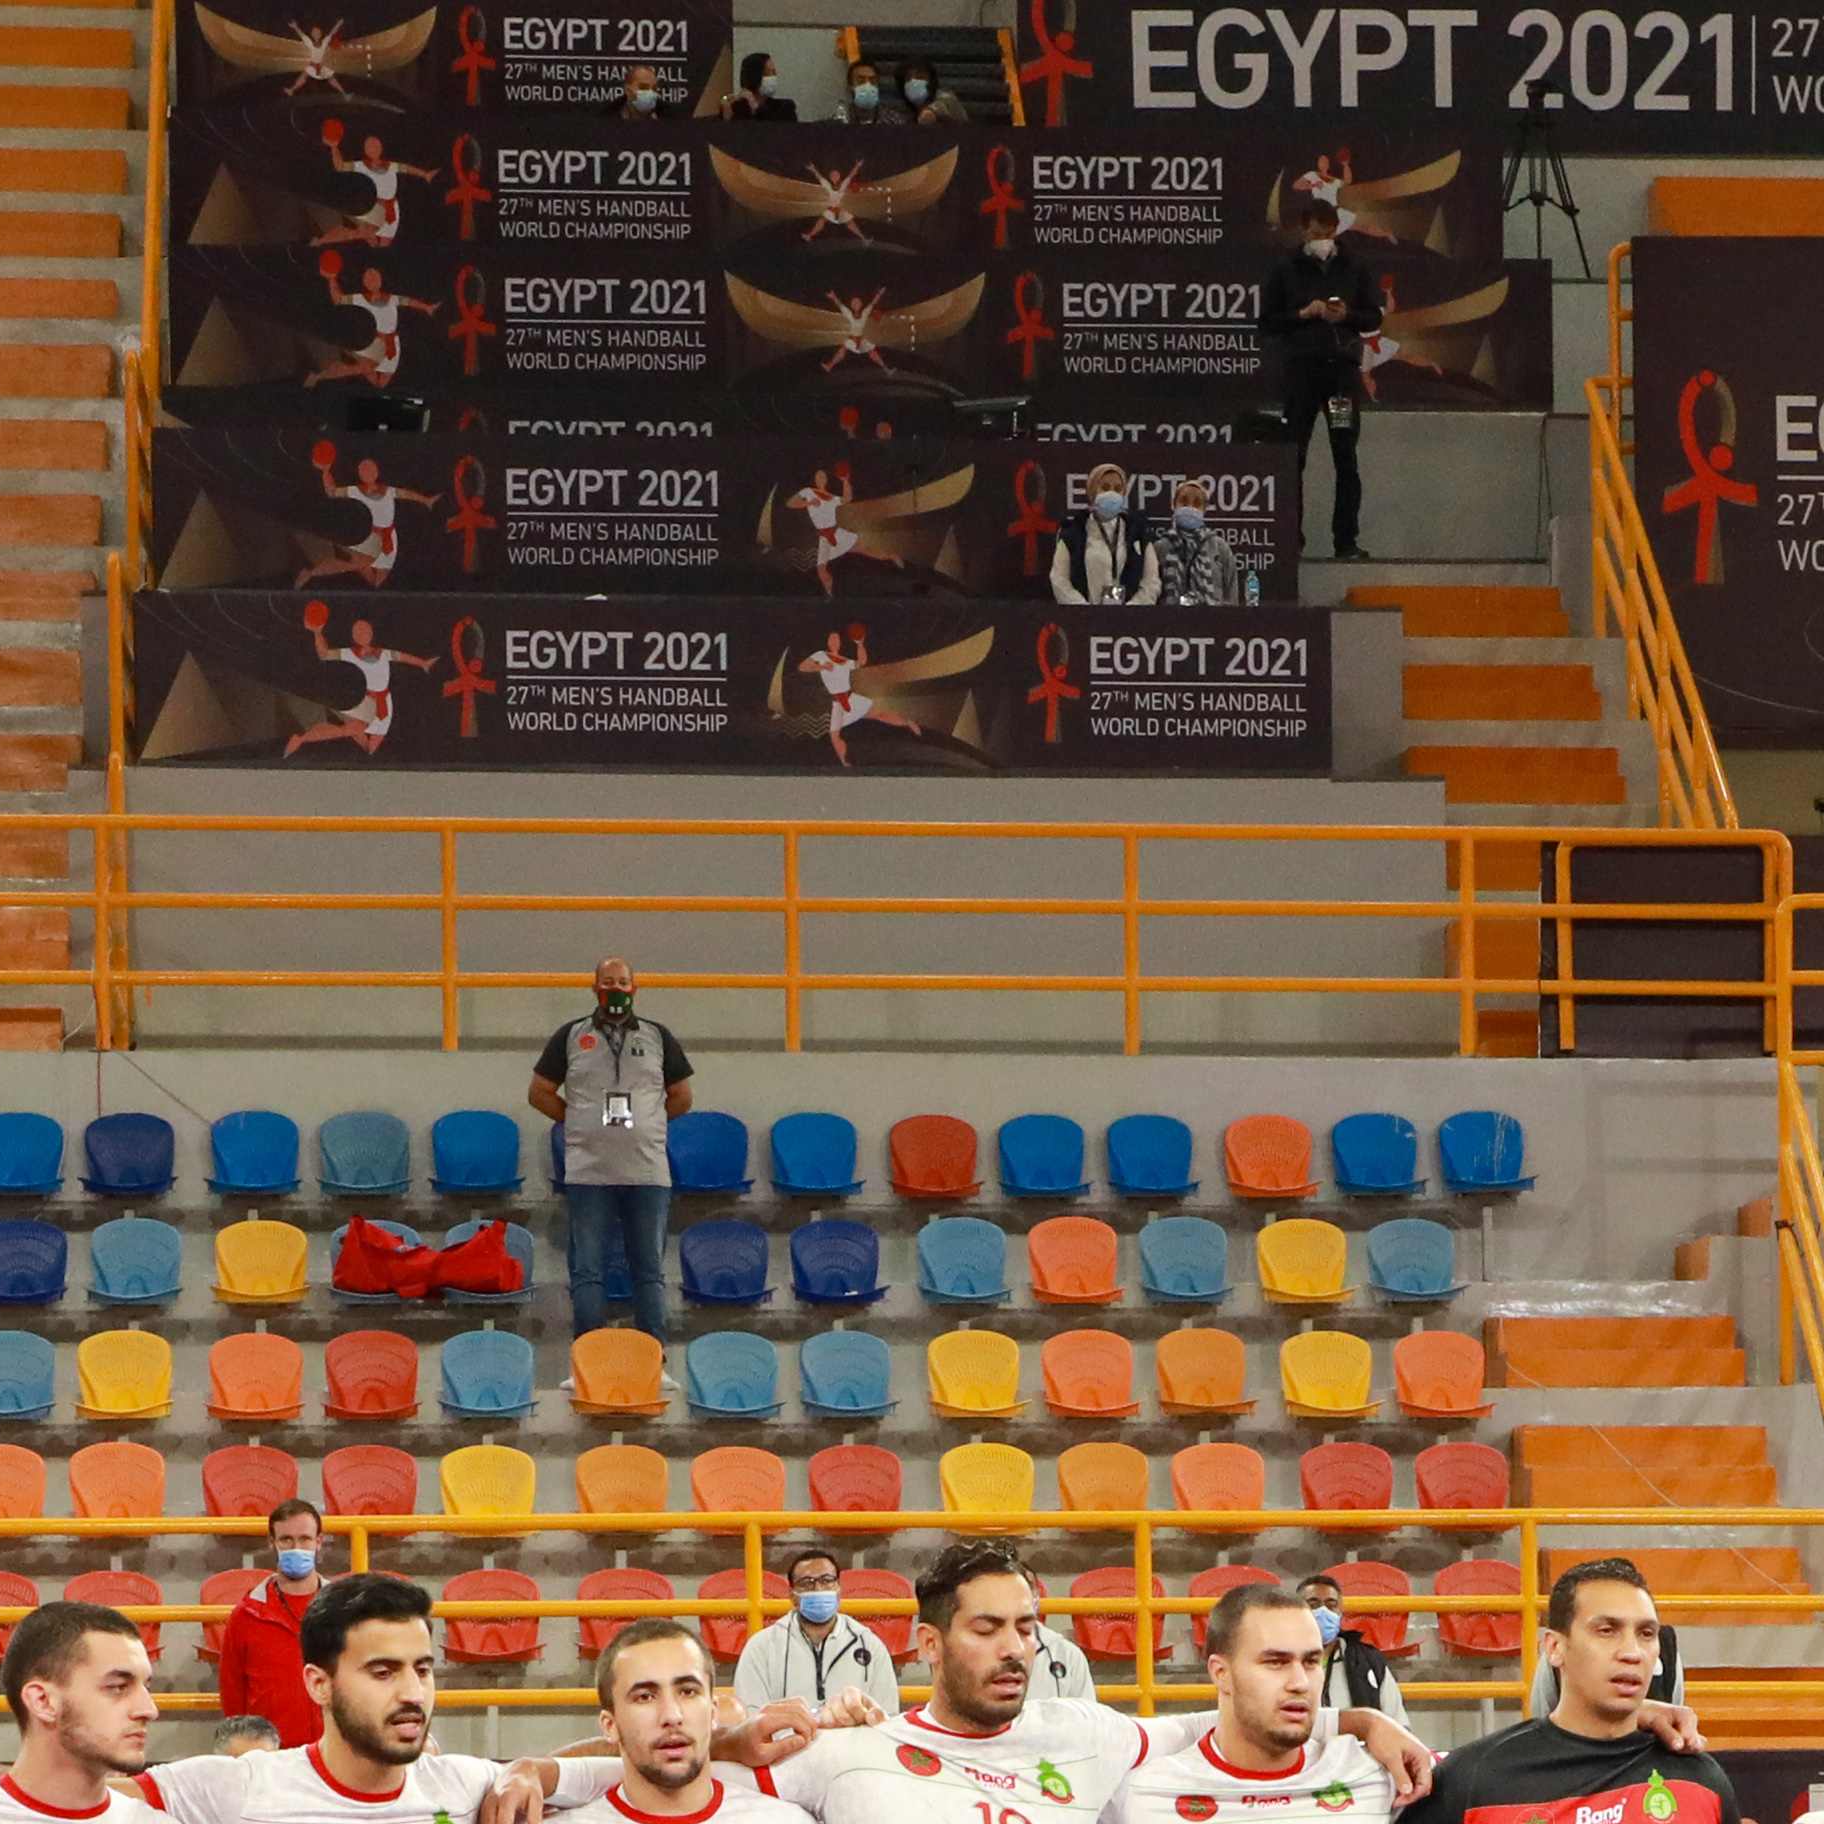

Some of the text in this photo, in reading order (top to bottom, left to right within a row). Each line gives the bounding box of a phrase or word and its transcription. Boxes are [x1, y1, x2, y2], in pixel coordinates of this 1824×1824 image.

[503, 16, 688, 53] EGYPT 2021
[1130, 7, 1734, 112] EGYPT 2021
[504, 85, 564, 101] WORLD
[497, 149, 691, 186] EGYPT 2021
[1032, 155, 1223, 191] EGYPT 2021
[537, 198, 592, 217] MEN'S
[595, 199, 692, 218] HANDBALL
[1071, 204, 1126, 222] MEN'S
[1129, 204, 1223, 223] HANDBALL
[498, 220, 692, 241] WORLD CHAMPIONSHIP
[1033, 226, 1224, 245] WORLD CHAMPIONSHIP
[504, 277, 706, 315] EGYPT 2021
[1062, 282, 1261, 319] EGYPT 2021
[545, 328, 603, 348] MEN'S
[607, 329, 707, 348] HANDBALL
[1103, 332, 1159, 351] MEN'S
[1162, 333, 1261, 352] HANDBALL
[505, 351, 707, 371] WORLD CHAMPIONSHIP
[1063, 354, 1262, 375] WORLD CHAMPIONSHIP
[505, 467, 719, 507] EGYPT 2021
[549, 521, 610, 542] MEN'S
[614, 522, 719, 542] HANDBALL
[507, 546, 720, 567] WORLD CHAMPIONSHIP
[505, 629, 728, 671] EGYPT 2021
[1089, 636, 1307, 677] EGYPT 2021
[551, 686, 614, 706] MEN'S
[618, 686, 729, 707] HANDBALL
[1134, 691, 1195, 712] MEN'S
[1200, 692, 1307, 714] HANDBALL
[506, 711, 729, 733] WORLD CHAMPIONSHIP
[1090, 716, 1308, 738] WORLD CHAMPIONSHIP
